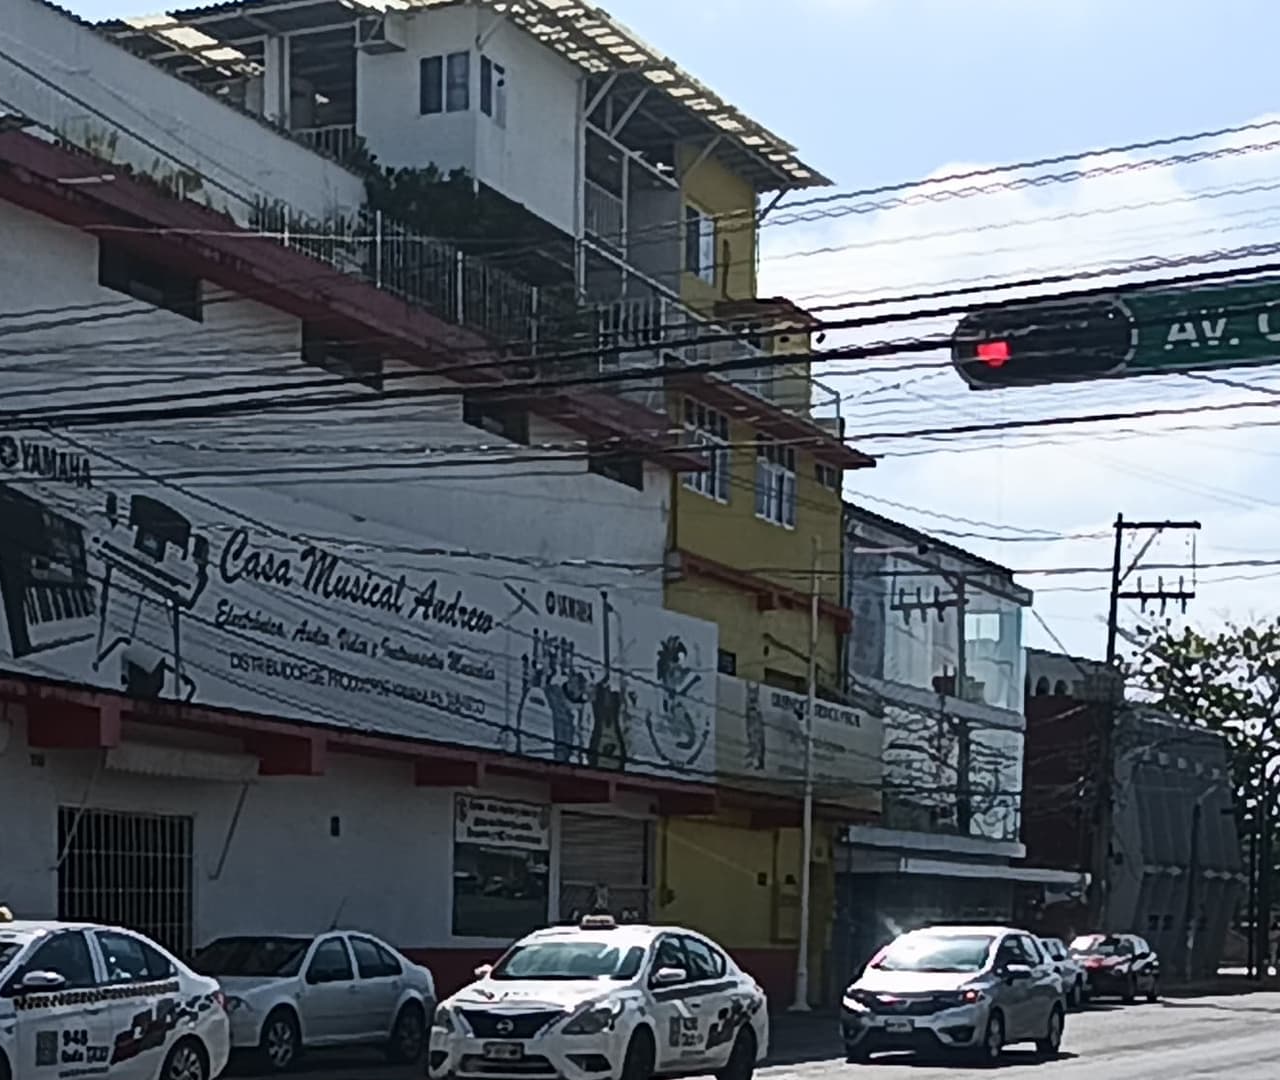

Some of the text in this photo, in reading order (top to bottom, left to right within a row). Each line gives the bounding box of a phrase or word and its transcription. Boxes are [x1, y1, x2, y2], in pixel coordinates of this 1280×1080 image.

[20, 437, 93, 490] YAMAHA
[219, 529, 293, 587] Casa
[300, 545, 405, 615] Musical
